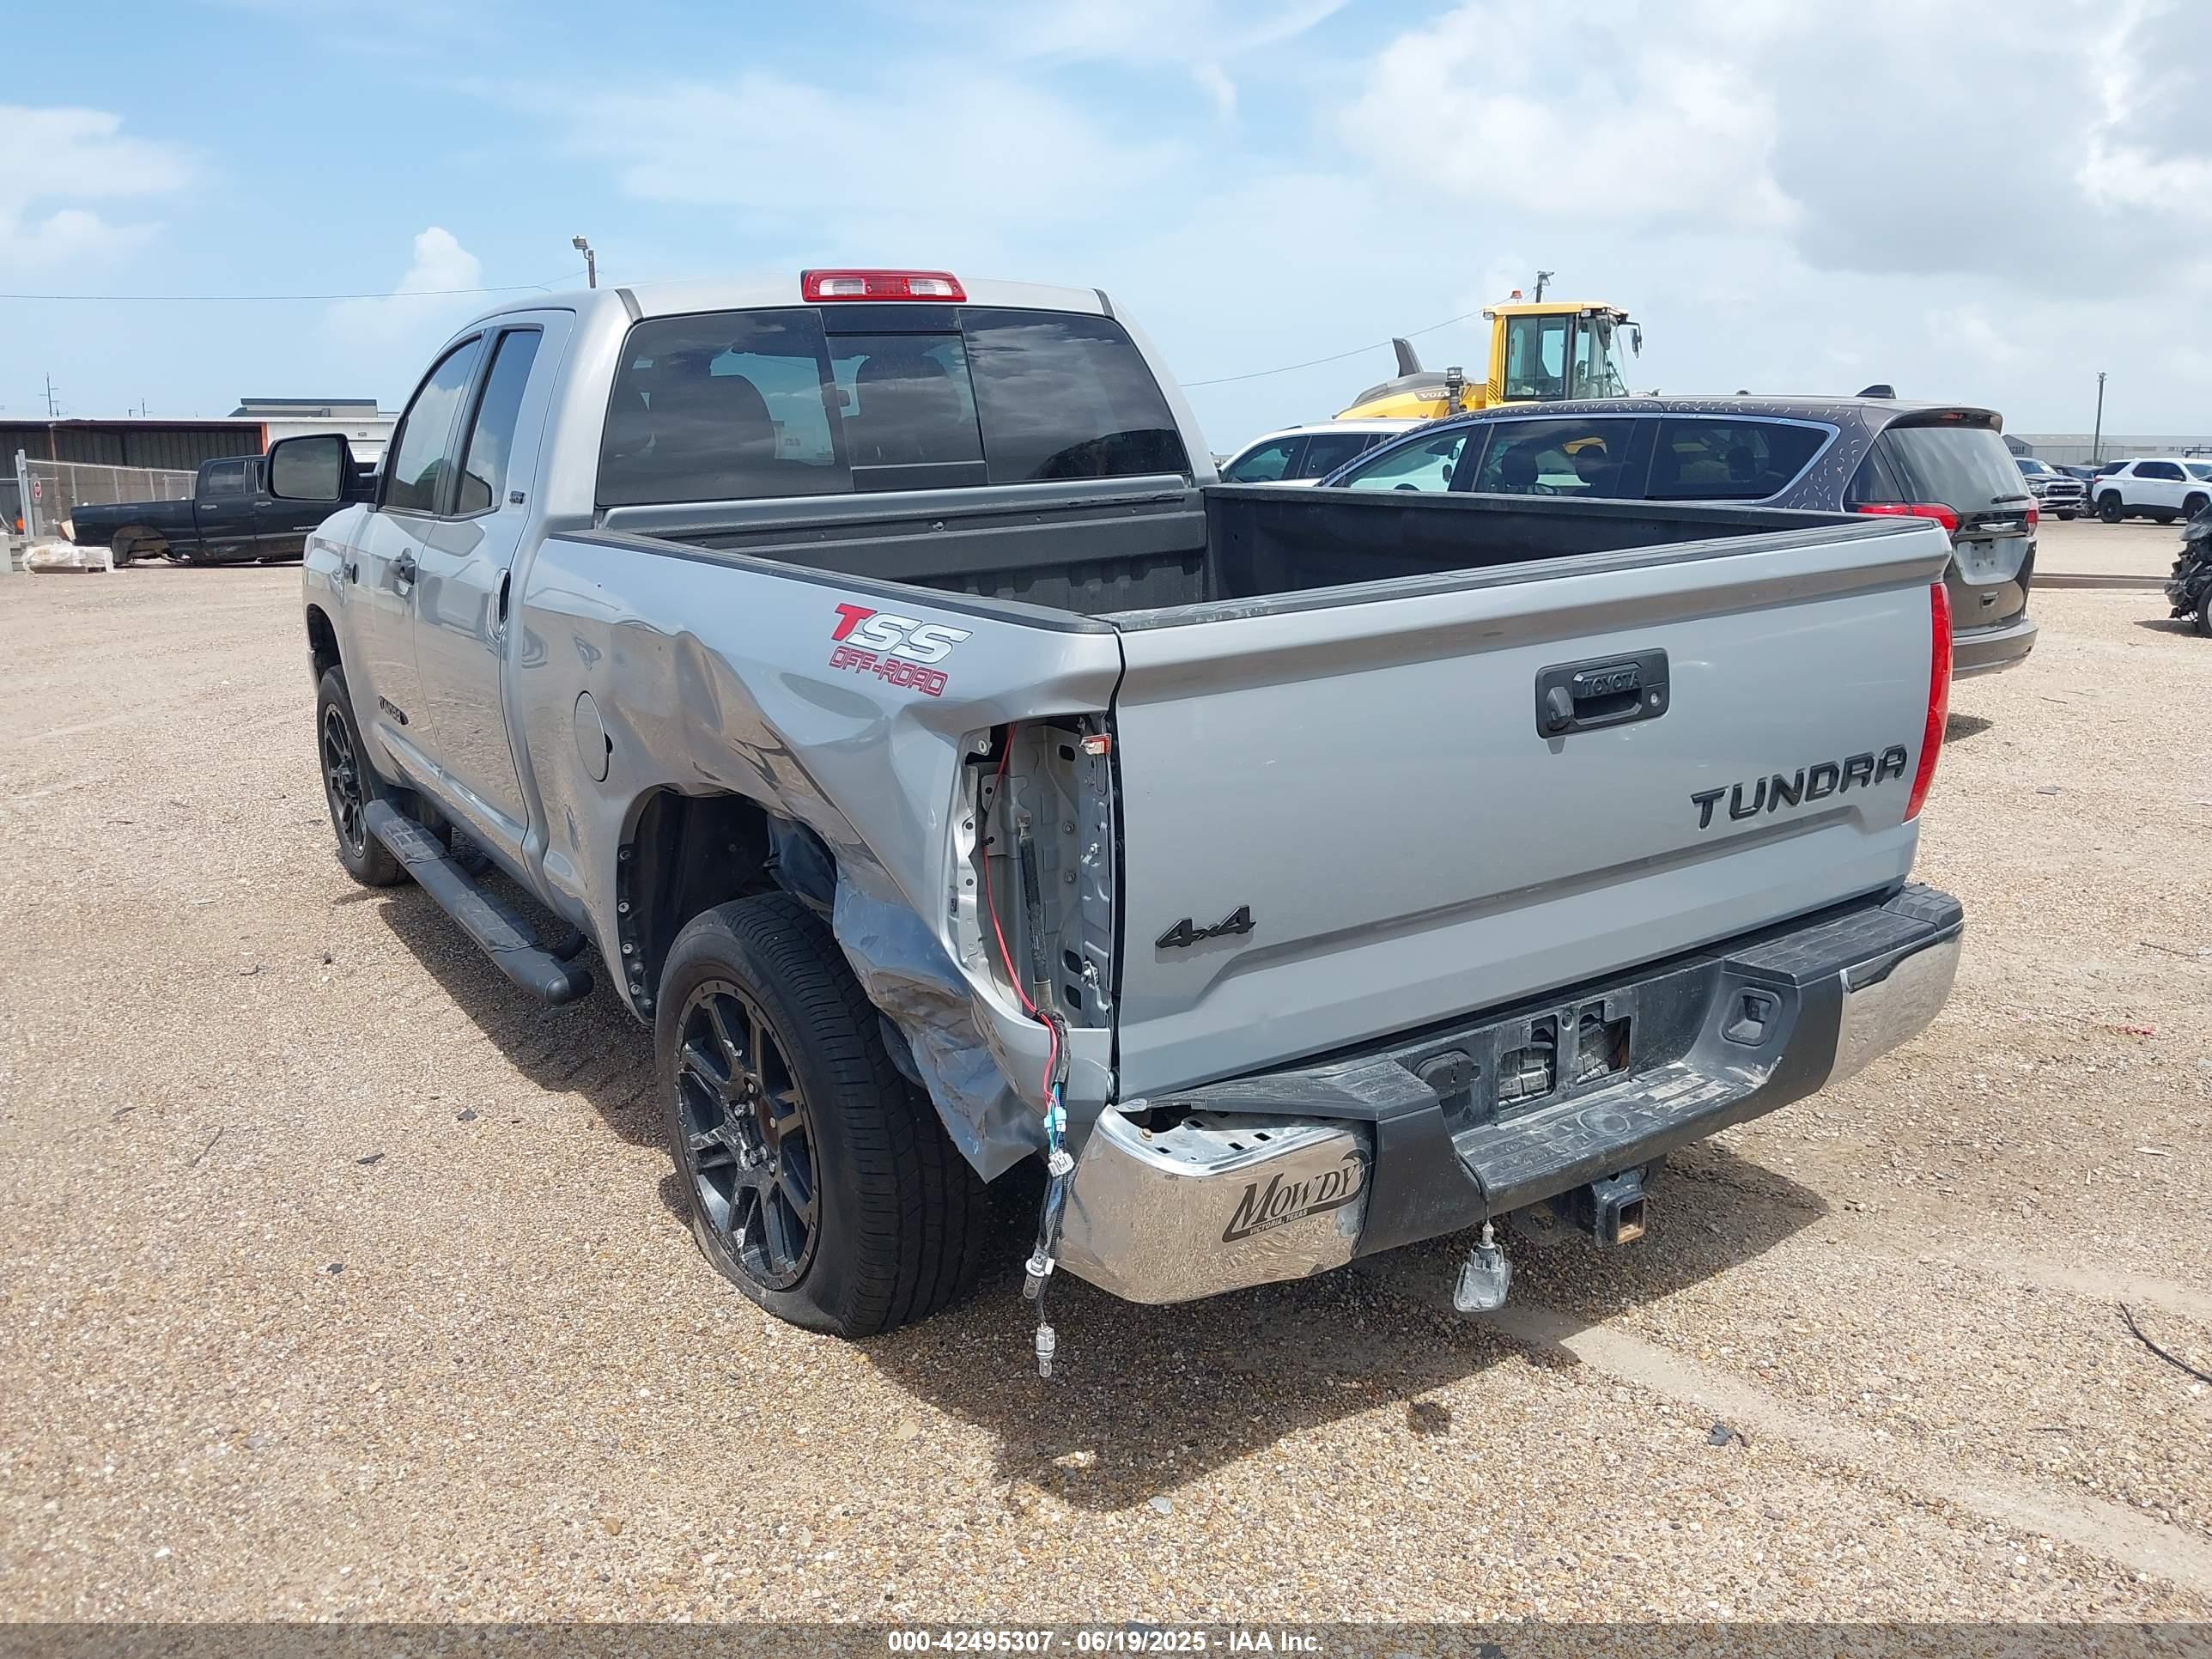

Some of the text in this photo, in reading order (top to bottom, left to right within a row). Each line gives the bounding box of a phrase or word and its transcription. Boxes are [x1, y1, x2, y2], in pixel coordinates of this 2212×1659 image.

[831, 603, 973, 664] TSS
[829, 646, 948, 696] OFF-ROAD
[1582, 671, 1641, 696] TOYOTA
[1690, 744, 1908, 830] TUNDRA
[1249, 1208, 1308, 1235] VICTORIA, TEXAS
